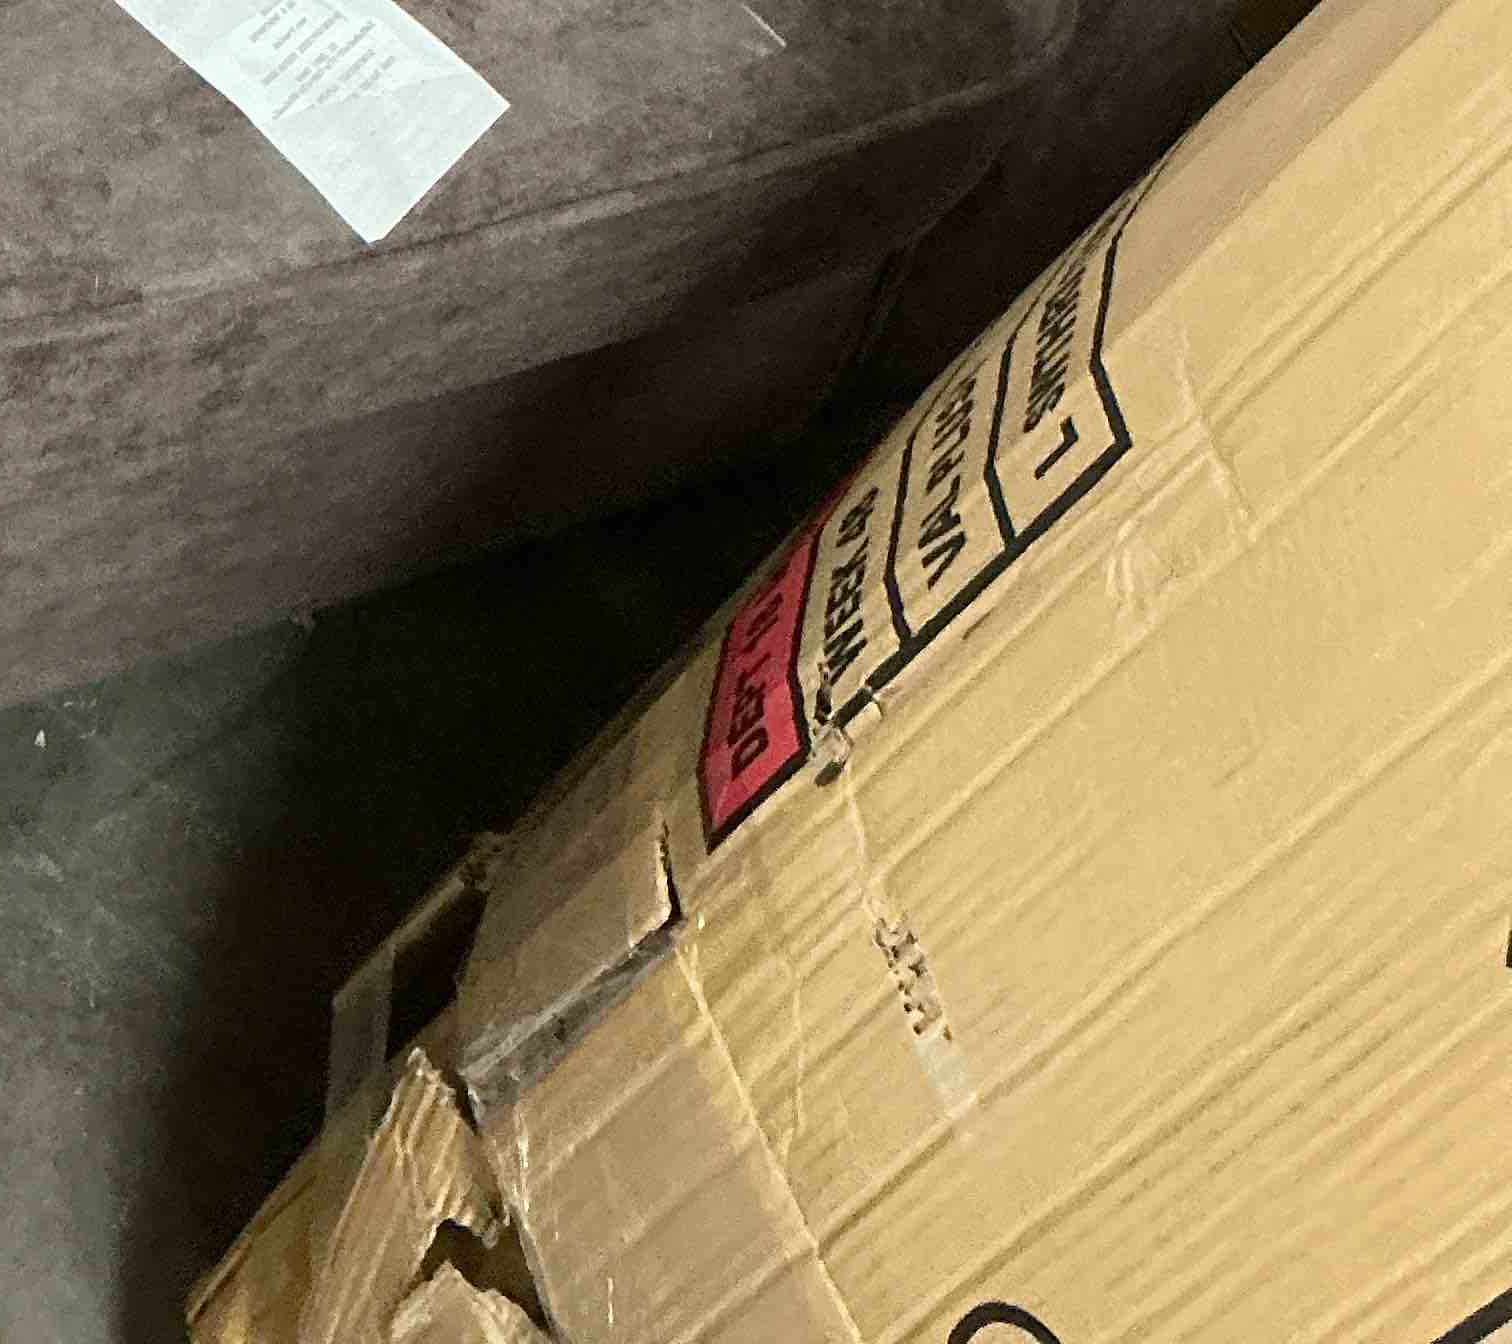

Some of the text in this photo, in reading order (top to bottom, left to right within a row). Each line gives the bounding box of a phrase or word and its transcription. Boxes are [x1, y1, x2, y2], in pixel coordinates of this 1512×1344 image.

[1033, 415, 1080, 481] L
[918, 474, 968, 591] VAL
[824, 534, 870, 687] WEEK
[726, 650, 773, 781] DEPT
